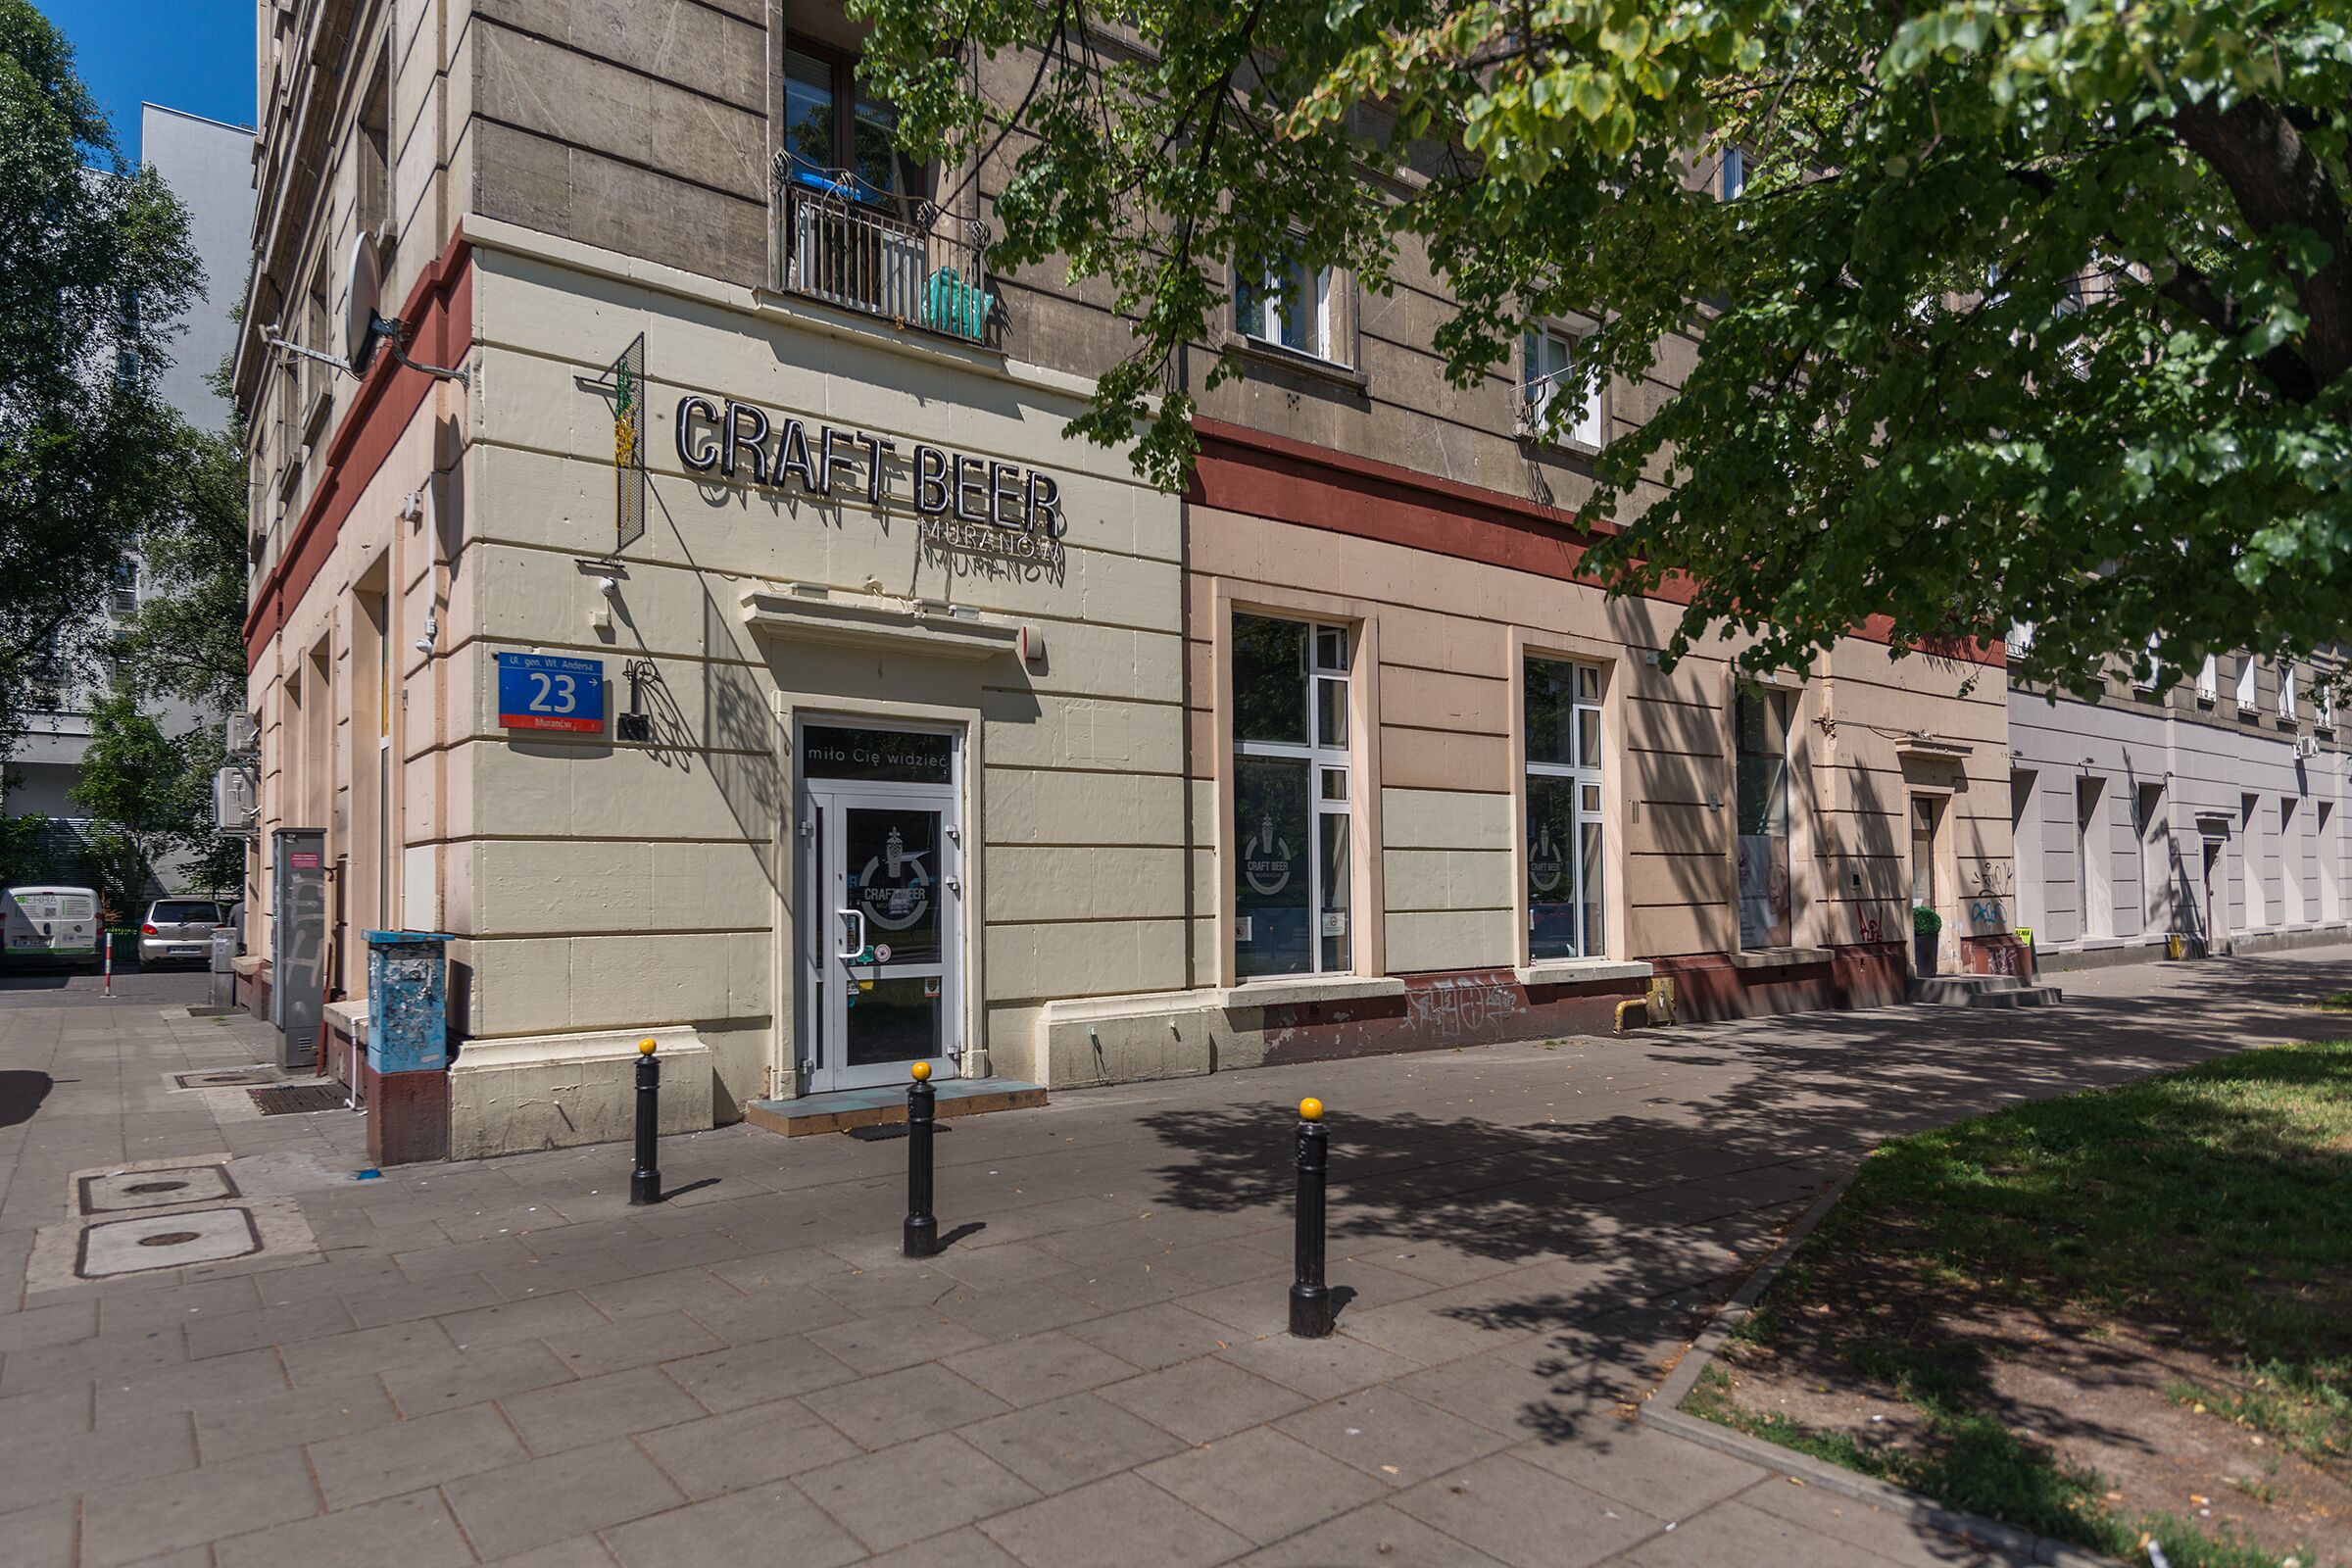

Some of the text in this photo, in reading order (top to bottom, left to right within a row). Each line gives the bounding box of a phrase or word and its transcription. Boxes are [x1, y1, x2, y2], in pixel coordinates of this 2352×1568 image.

[676, 395, 1061, 538] CRAFT BEER
[524, 659, 541, 667] gen.
[562, 661, 594, 671] Andersa
[529, 672, 576, 713] 23
[808, 746, 948, 767] miło Cię widzieć
[1248, 861, 1288, 870] CRAFT BEER
